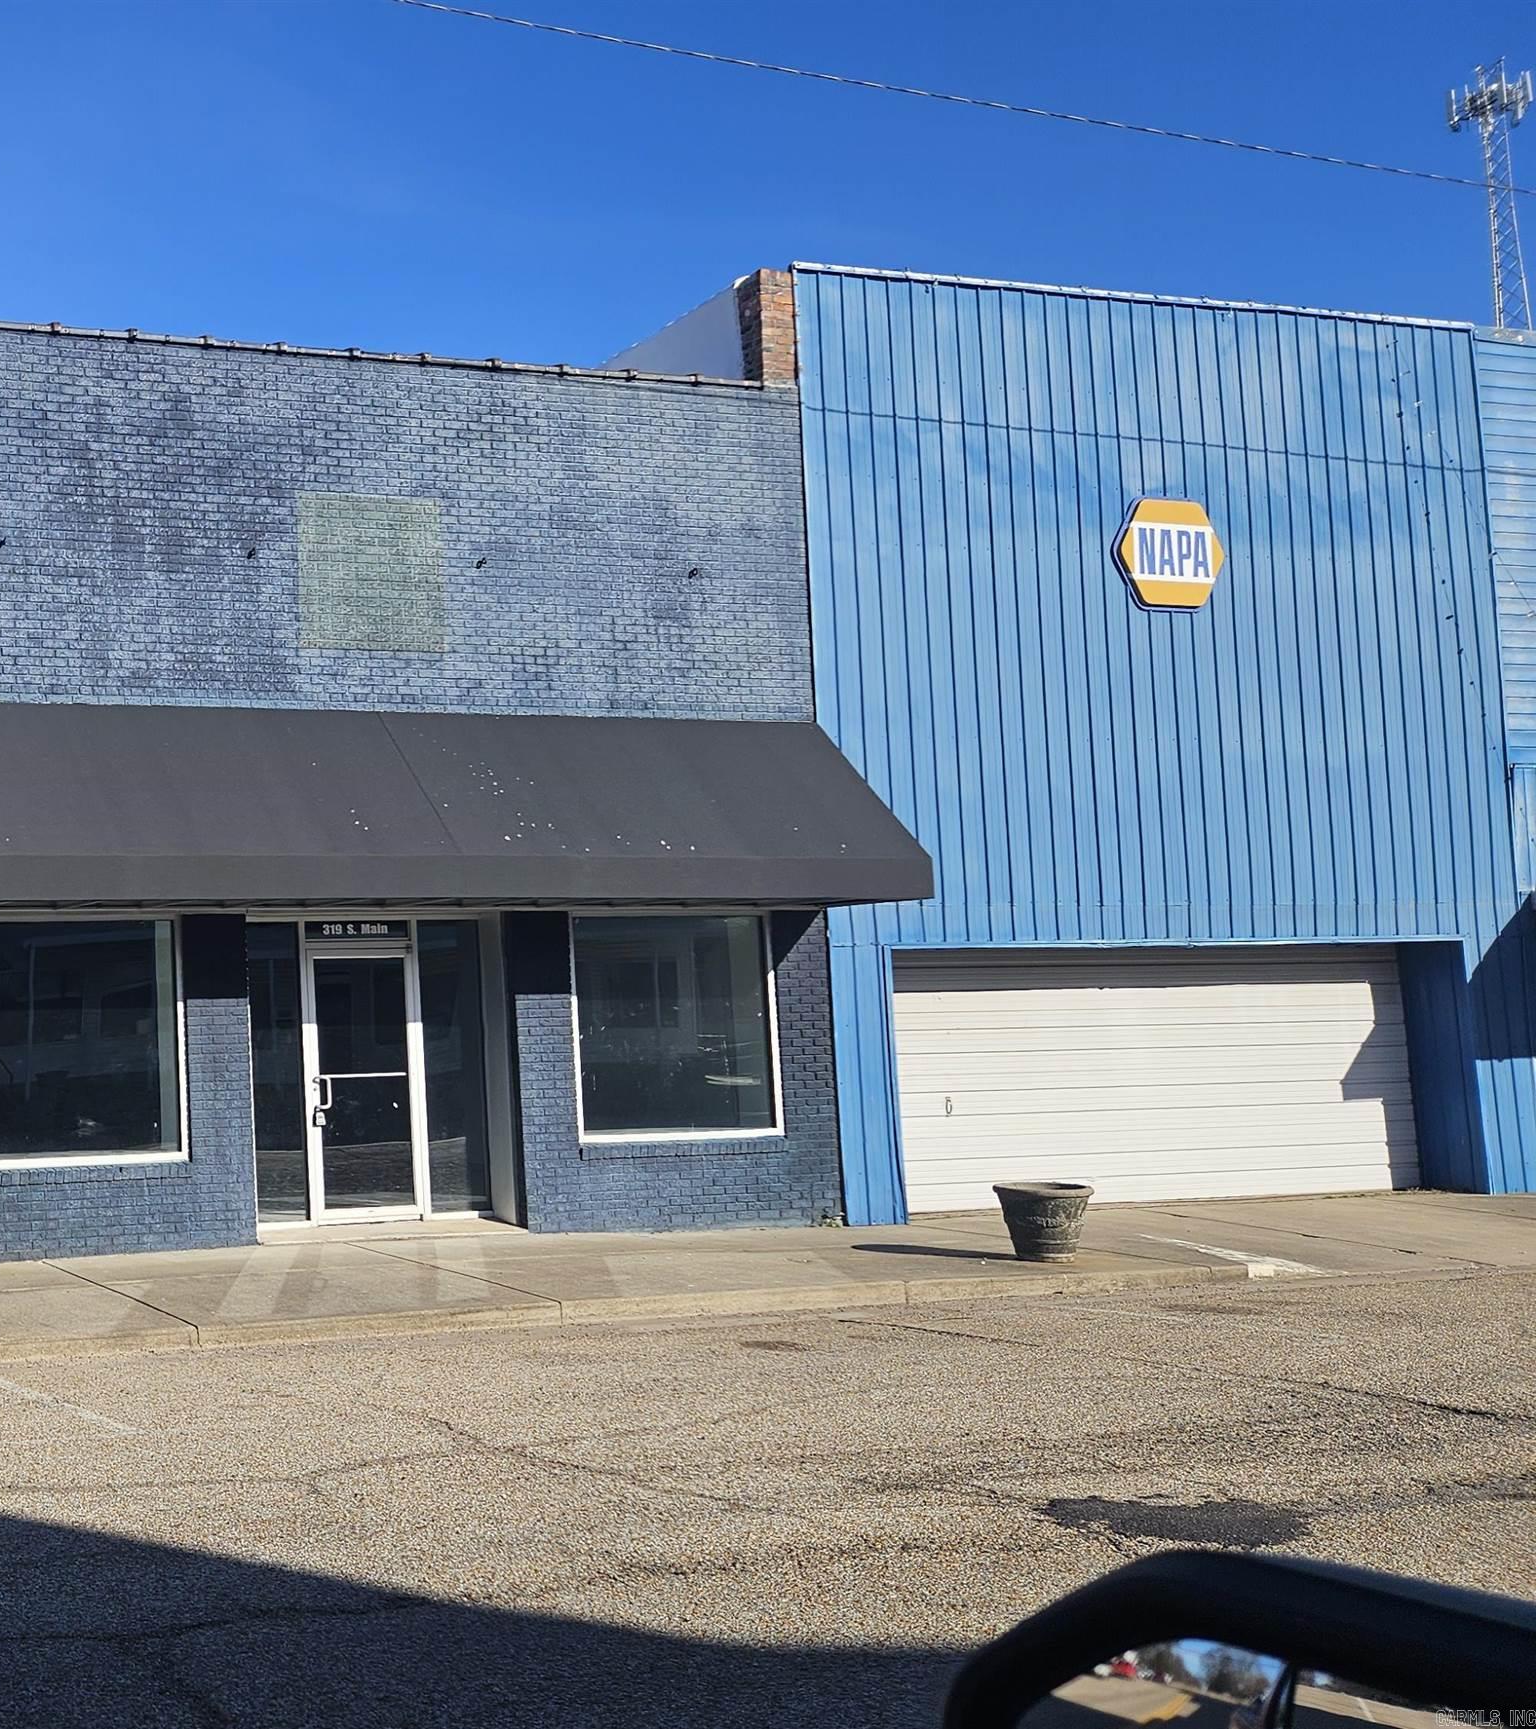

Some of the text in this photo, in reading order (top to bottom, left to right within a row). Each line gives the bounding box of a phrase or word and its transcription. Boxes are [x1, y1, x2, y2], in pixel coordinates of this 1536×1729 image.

[1138, 527, 1211, 578] NAPA
[322, 923, 389, 935] 319 S. Main
